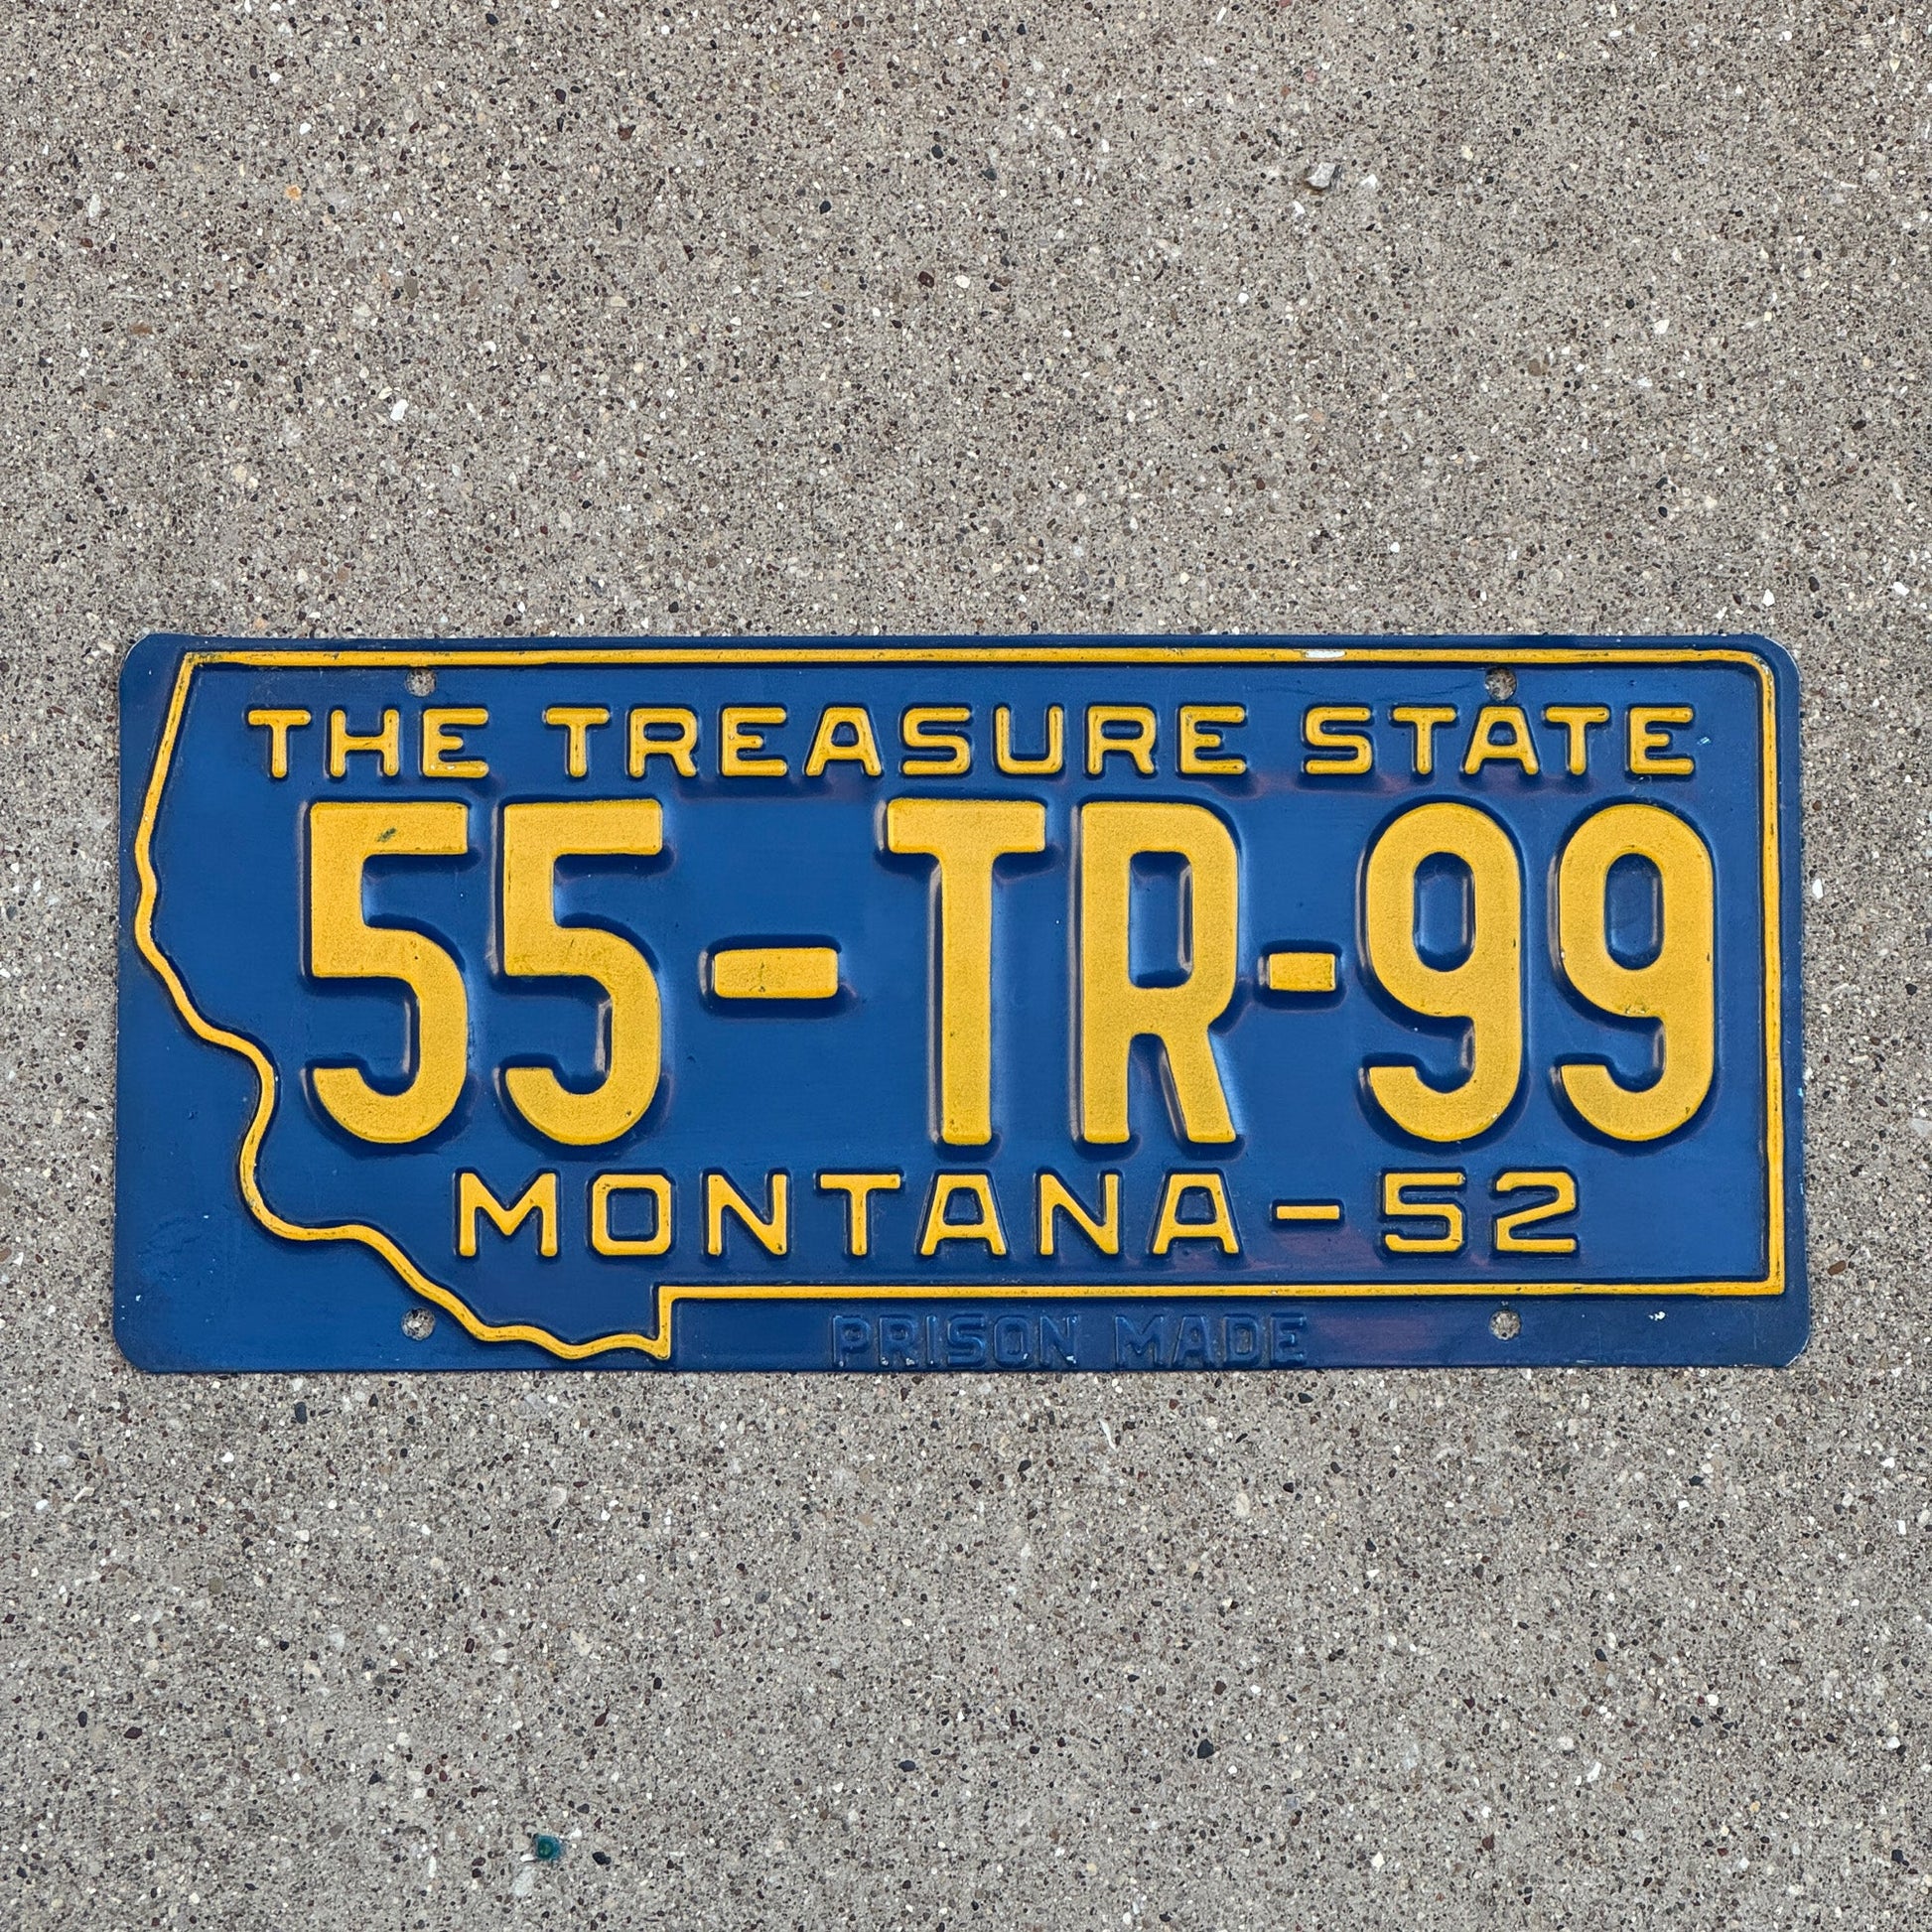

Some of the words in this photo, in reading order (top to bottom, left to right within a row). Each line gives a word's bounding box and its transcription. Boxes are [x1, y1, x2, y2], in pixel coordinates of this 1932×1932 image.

[247, 707, 489, 778] THE
[545, 706, 1245, 777] TREASURE
[1305, 706, 1694, 775] STATE
[831, 1313, 1080, 1369] PRISON
[1114, 1313, 1308, 1369] MADE
